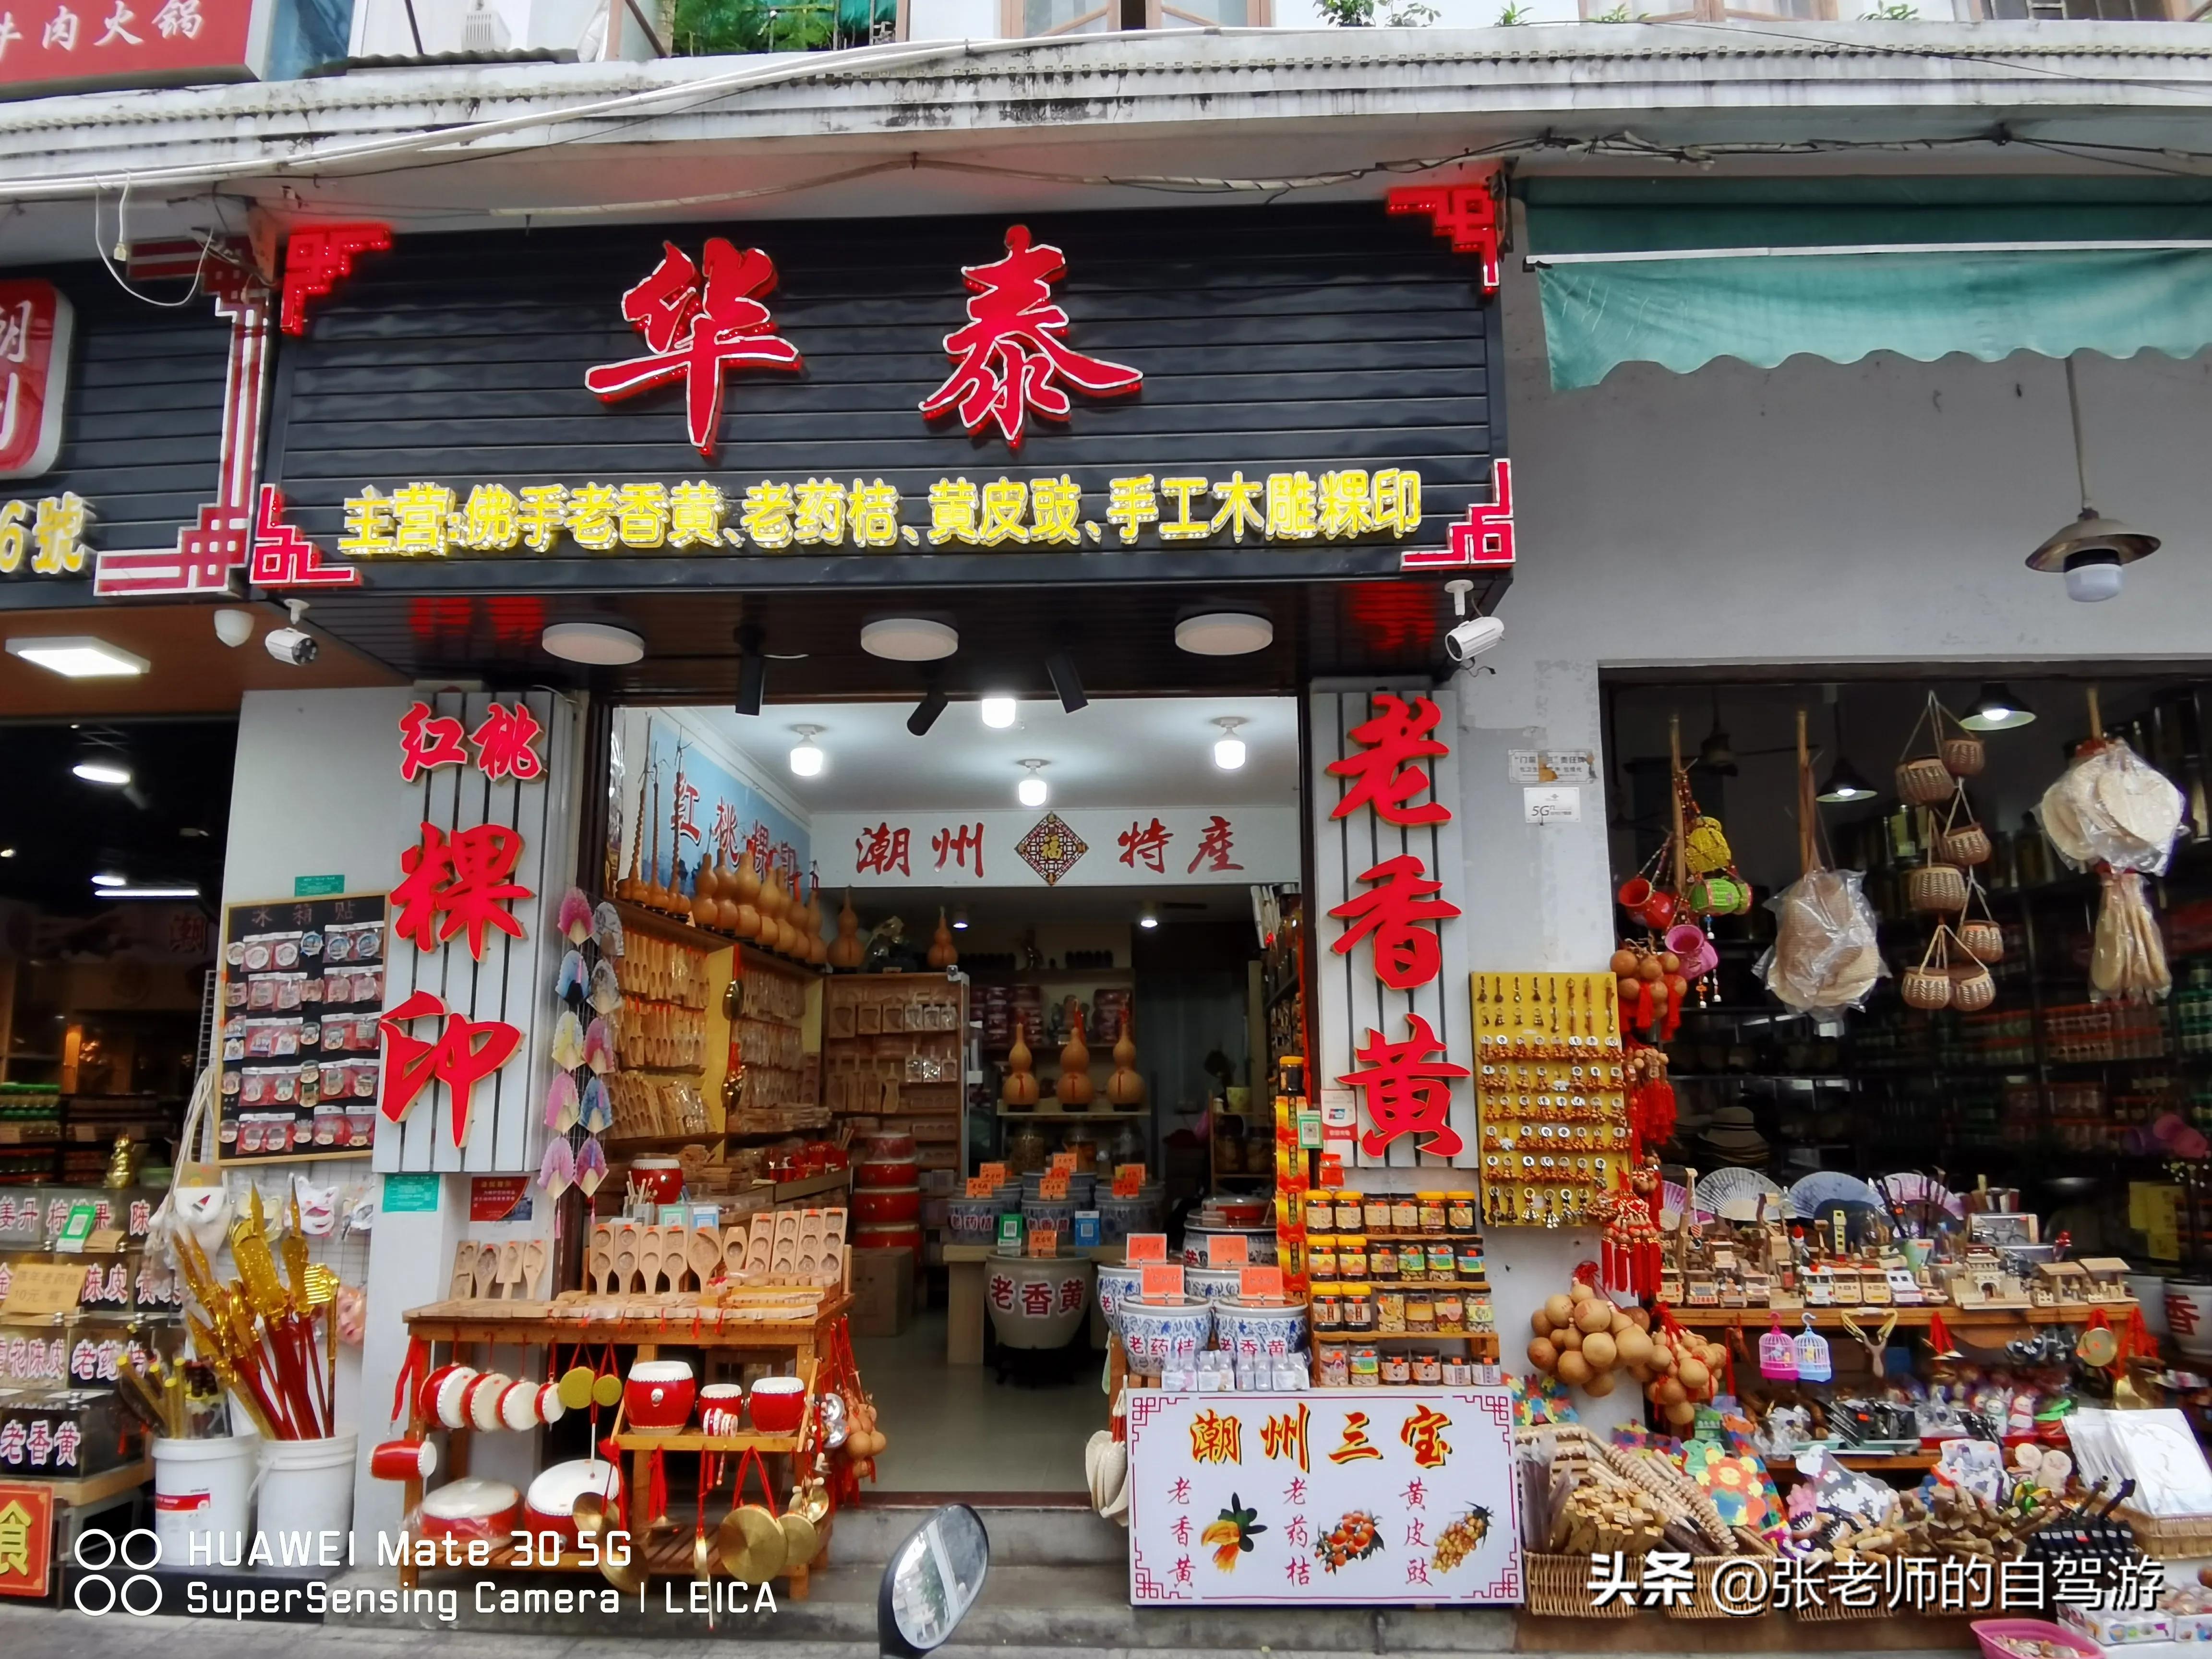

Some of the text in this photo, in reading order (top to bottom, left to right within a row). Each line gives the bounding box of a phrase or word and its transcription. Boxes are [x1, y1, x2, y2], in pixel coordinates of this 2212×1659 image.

[585, 225, 1144, 457] 华泰
[856, 822, 985, 878] 潮州
[252, 901, 356, 927] 冰箱贴
[1324, 694, 1471, 1158] 老香黄
[990, 1274, 1086, 1317] 老香黄
[0, 1419, 81, 1467] 老香黄
[1190, 1403, 1454, 1473] 潮州三宝
[1167, 1476, 1193, 1588] 老香黄
[1283, 1476, 1311, 1587] 老药桔
[1399, 1476, 1432, 1587] 黄皮豉
